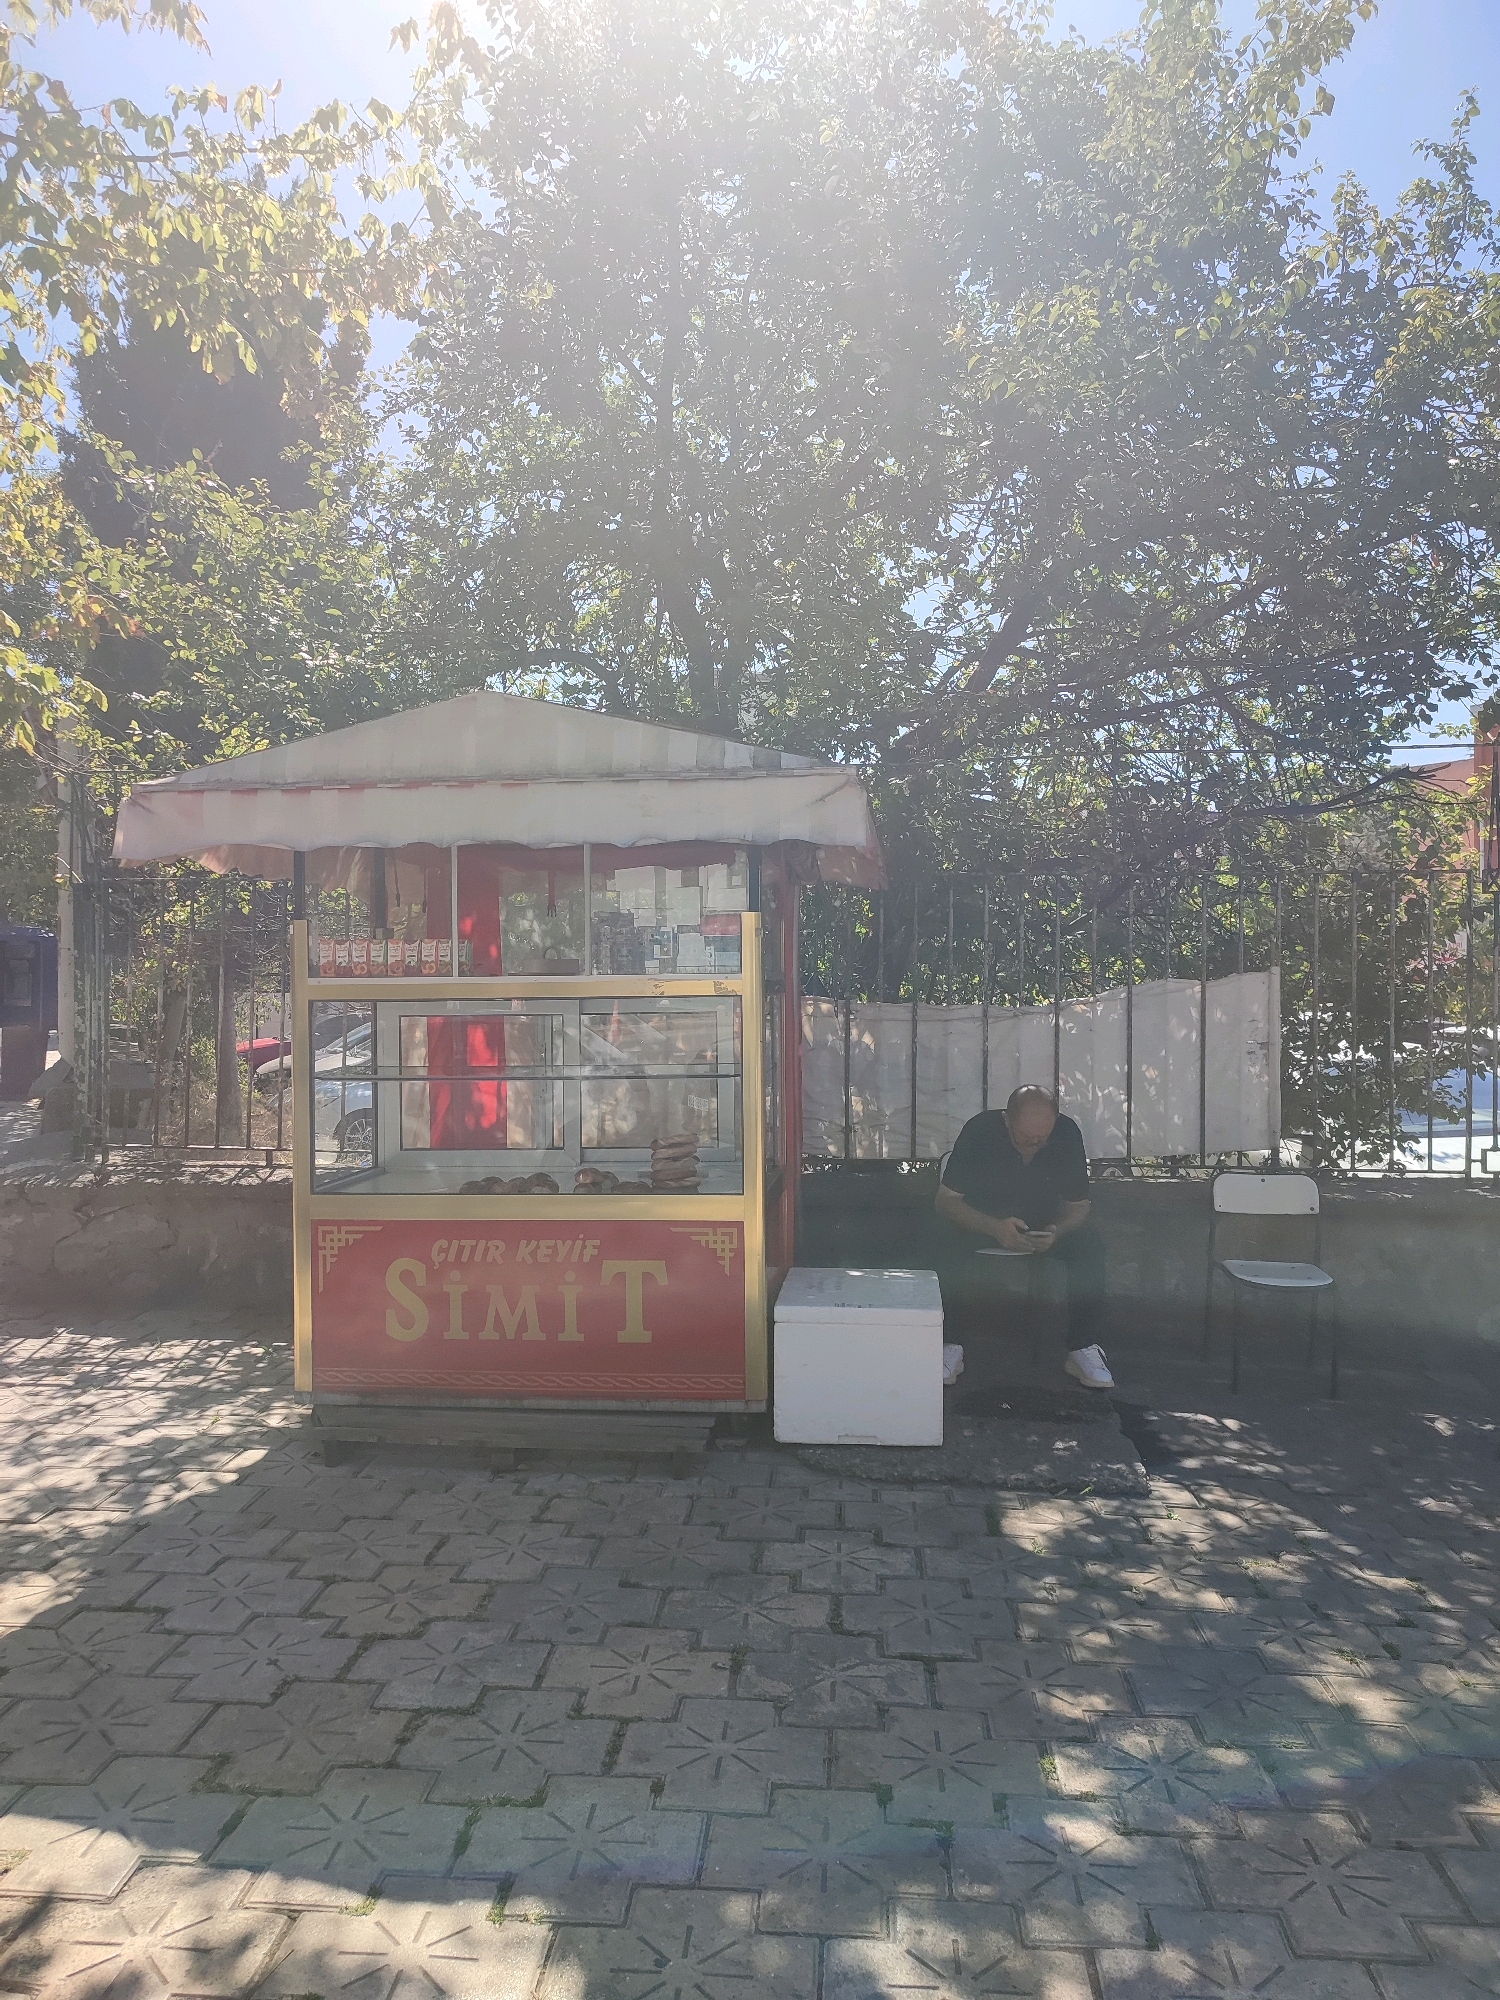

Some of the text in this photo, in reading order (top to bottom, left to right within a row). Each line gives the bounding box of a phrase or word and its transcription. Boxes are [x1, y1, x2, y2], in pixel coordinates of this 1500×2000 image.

[431, 1234, 600, 1269] ÇITIR KEYİF
[385, 1257, 668, 1343] SİMİT
